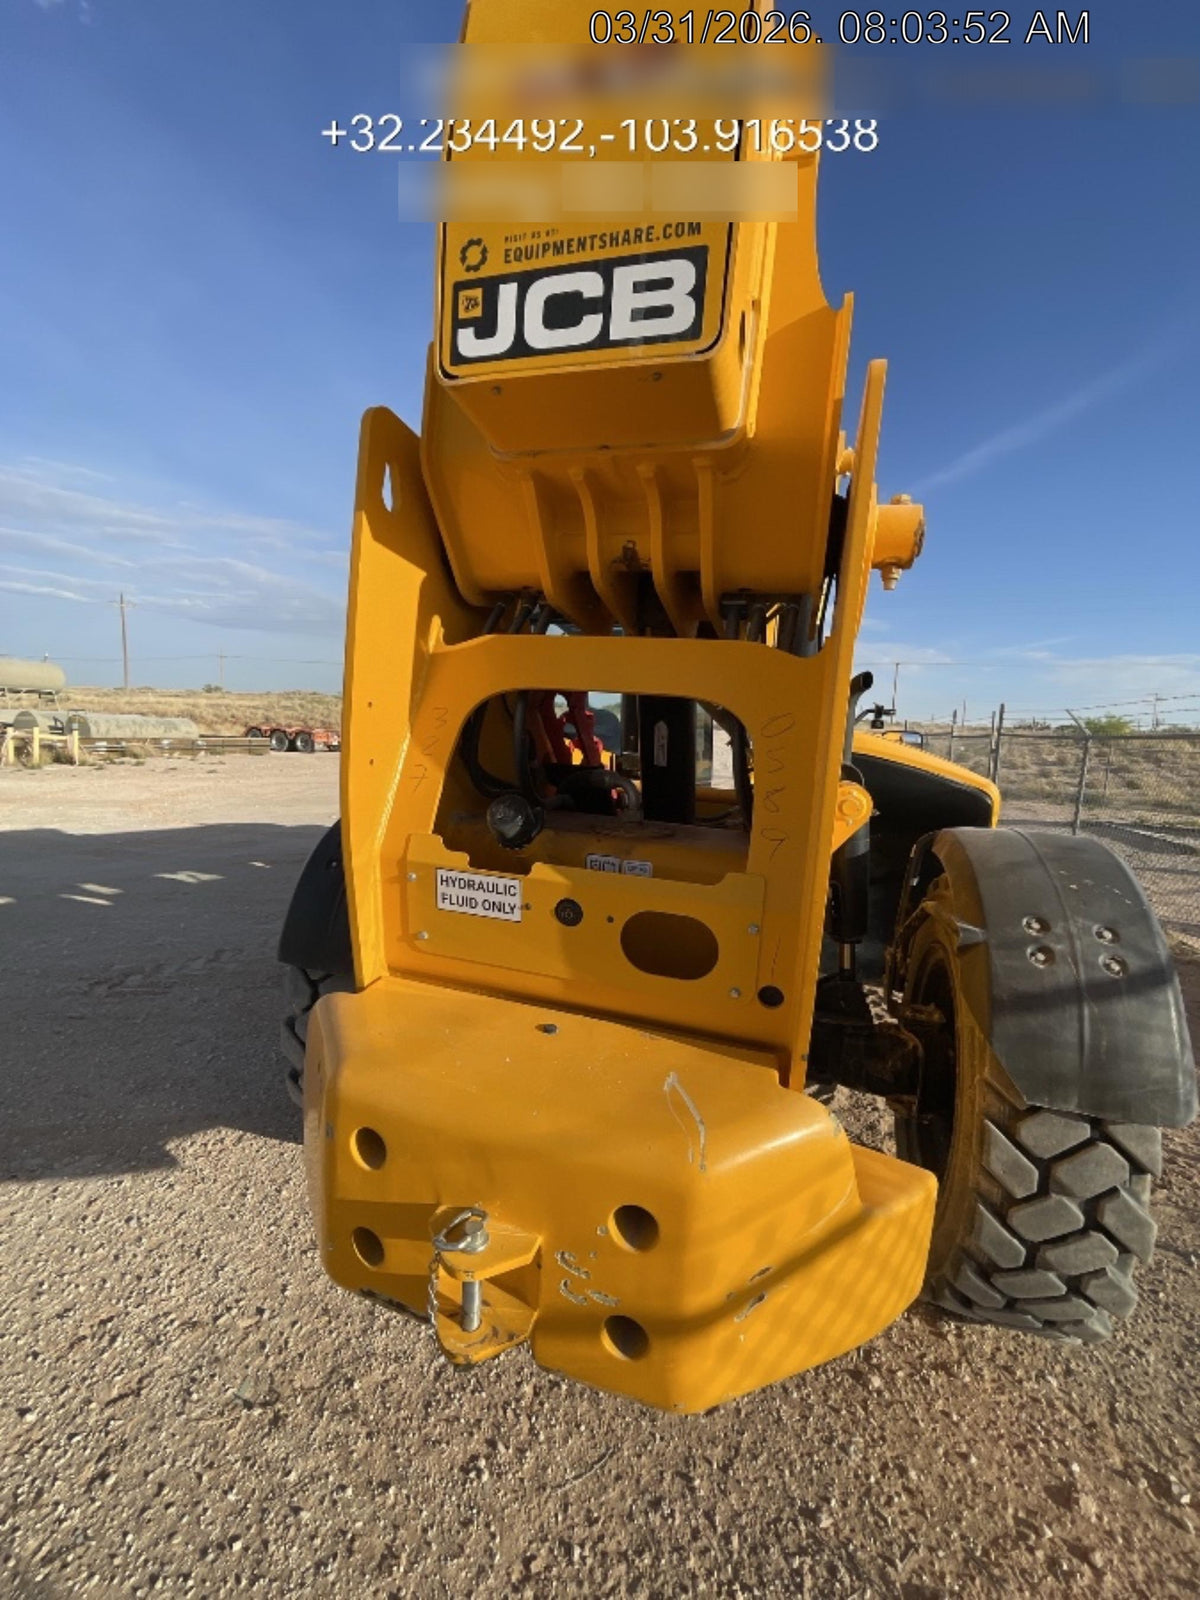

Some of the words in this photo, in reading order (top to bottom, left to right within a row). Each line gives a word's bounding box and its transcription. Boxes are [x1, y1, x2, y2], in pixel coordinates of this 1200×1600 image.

[504, 222, 702, 264] EQUIPMENTSHARE.COM
[456, 258, 697, 359] JCB
[440, 874, 517, 897] HYDRAULIC
[441, 892, 478, 910] FLUID
[481, 899, 517, 915] ONLY
